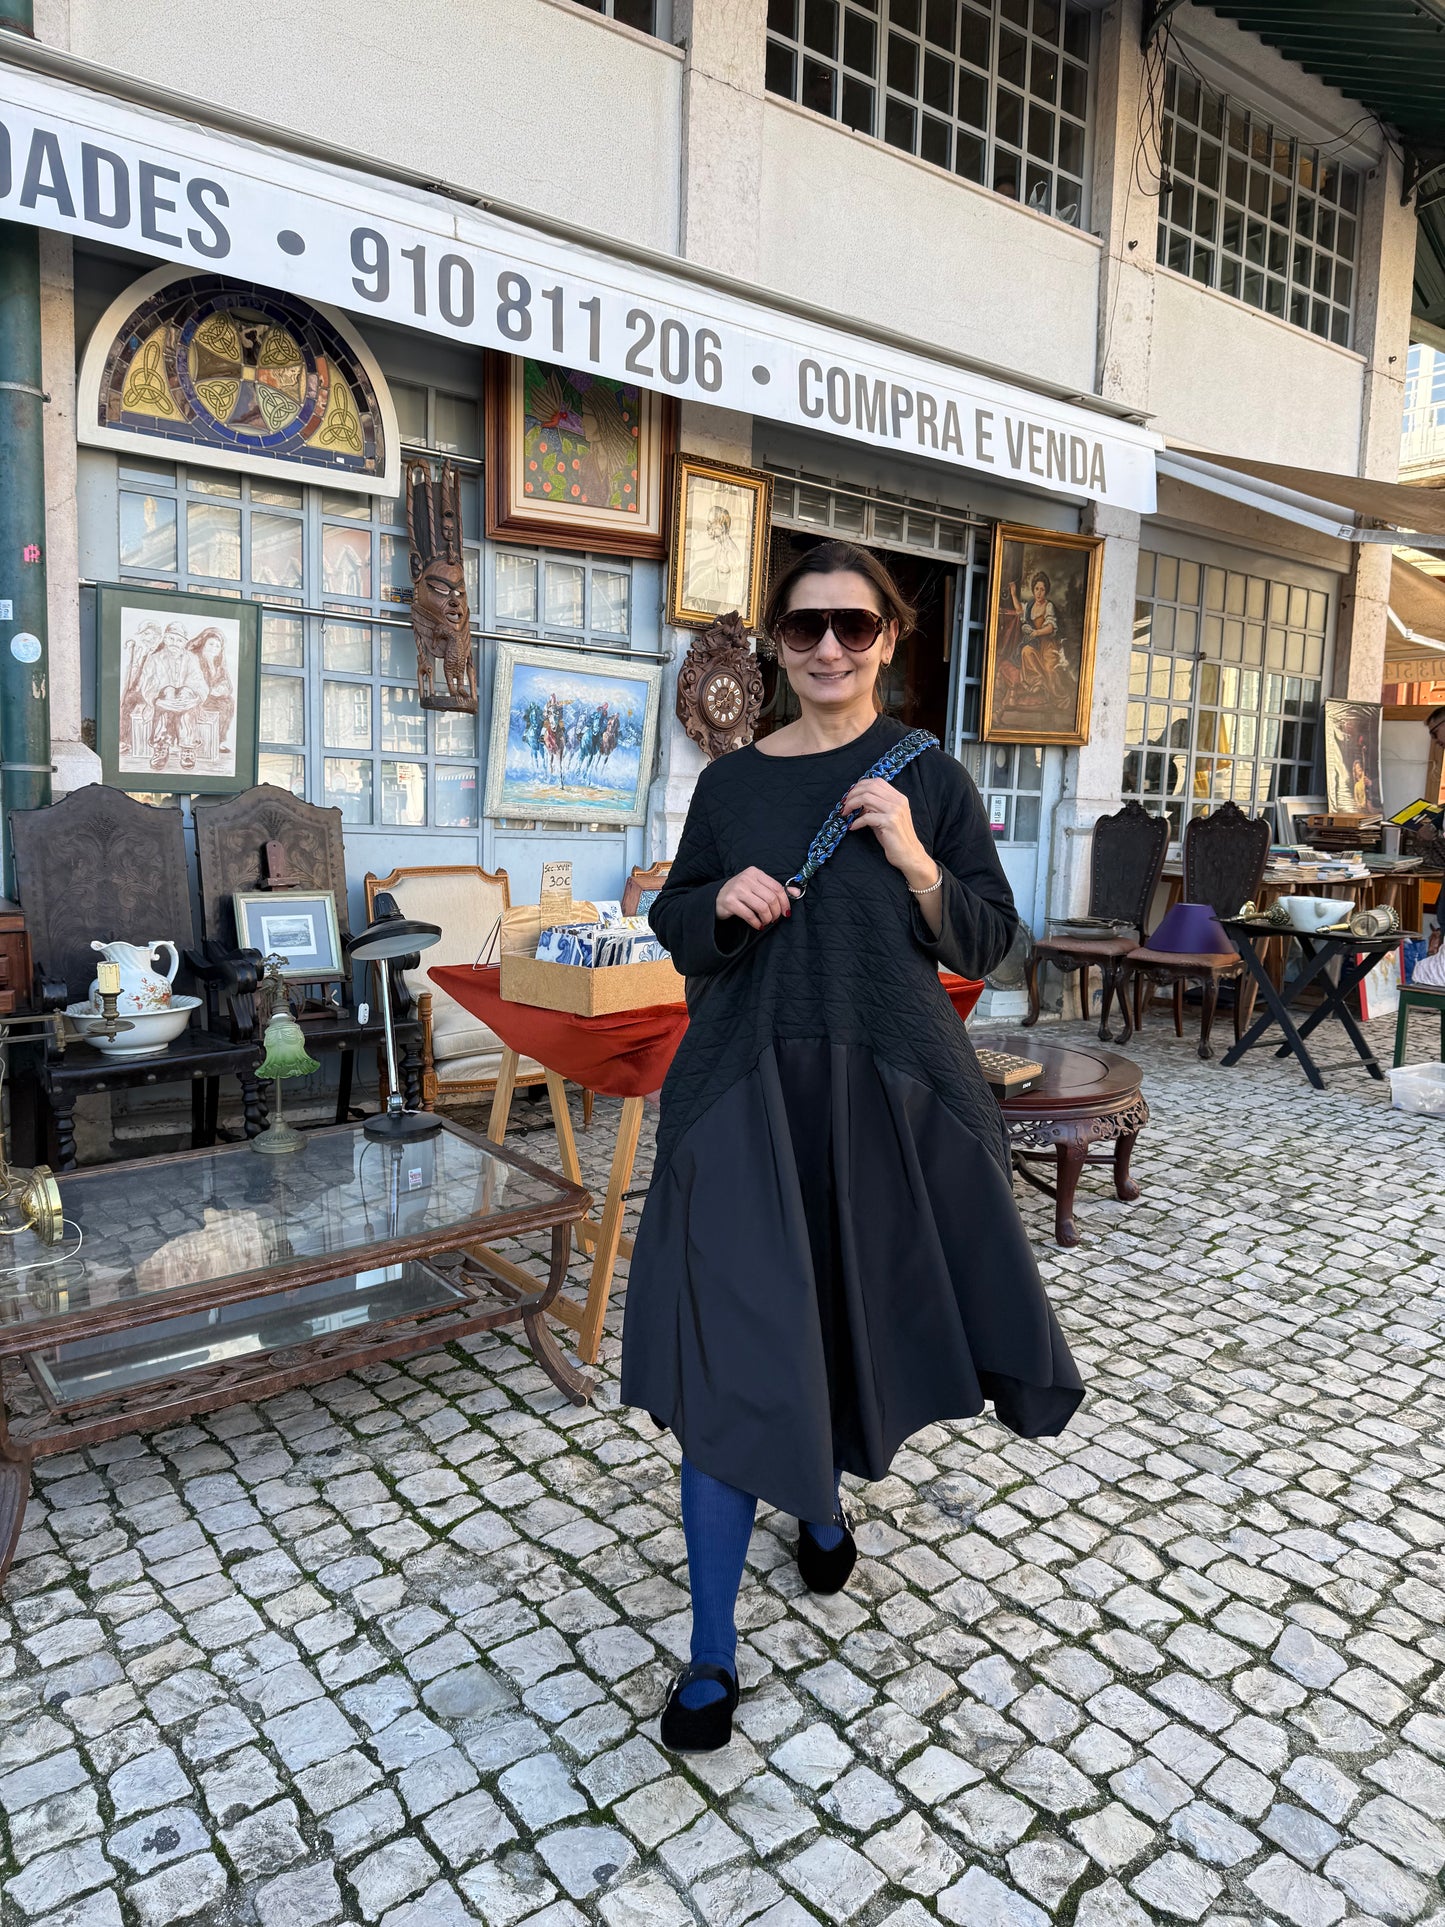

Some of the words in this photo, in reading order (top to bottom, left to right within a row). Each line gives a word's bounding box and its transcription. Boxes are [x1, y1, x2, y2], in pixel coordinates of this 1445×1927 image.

[0, 121, 231, 259] ADES
[350, 227, 474, 327] 910
[497, 271, 600, 363] 811
[625, 308, 723, 393] 206
[799, 359, 963, 456] COMPRA
[975, 408, 995, 464] E
[1005, 417, 1107, 493] VENDA
